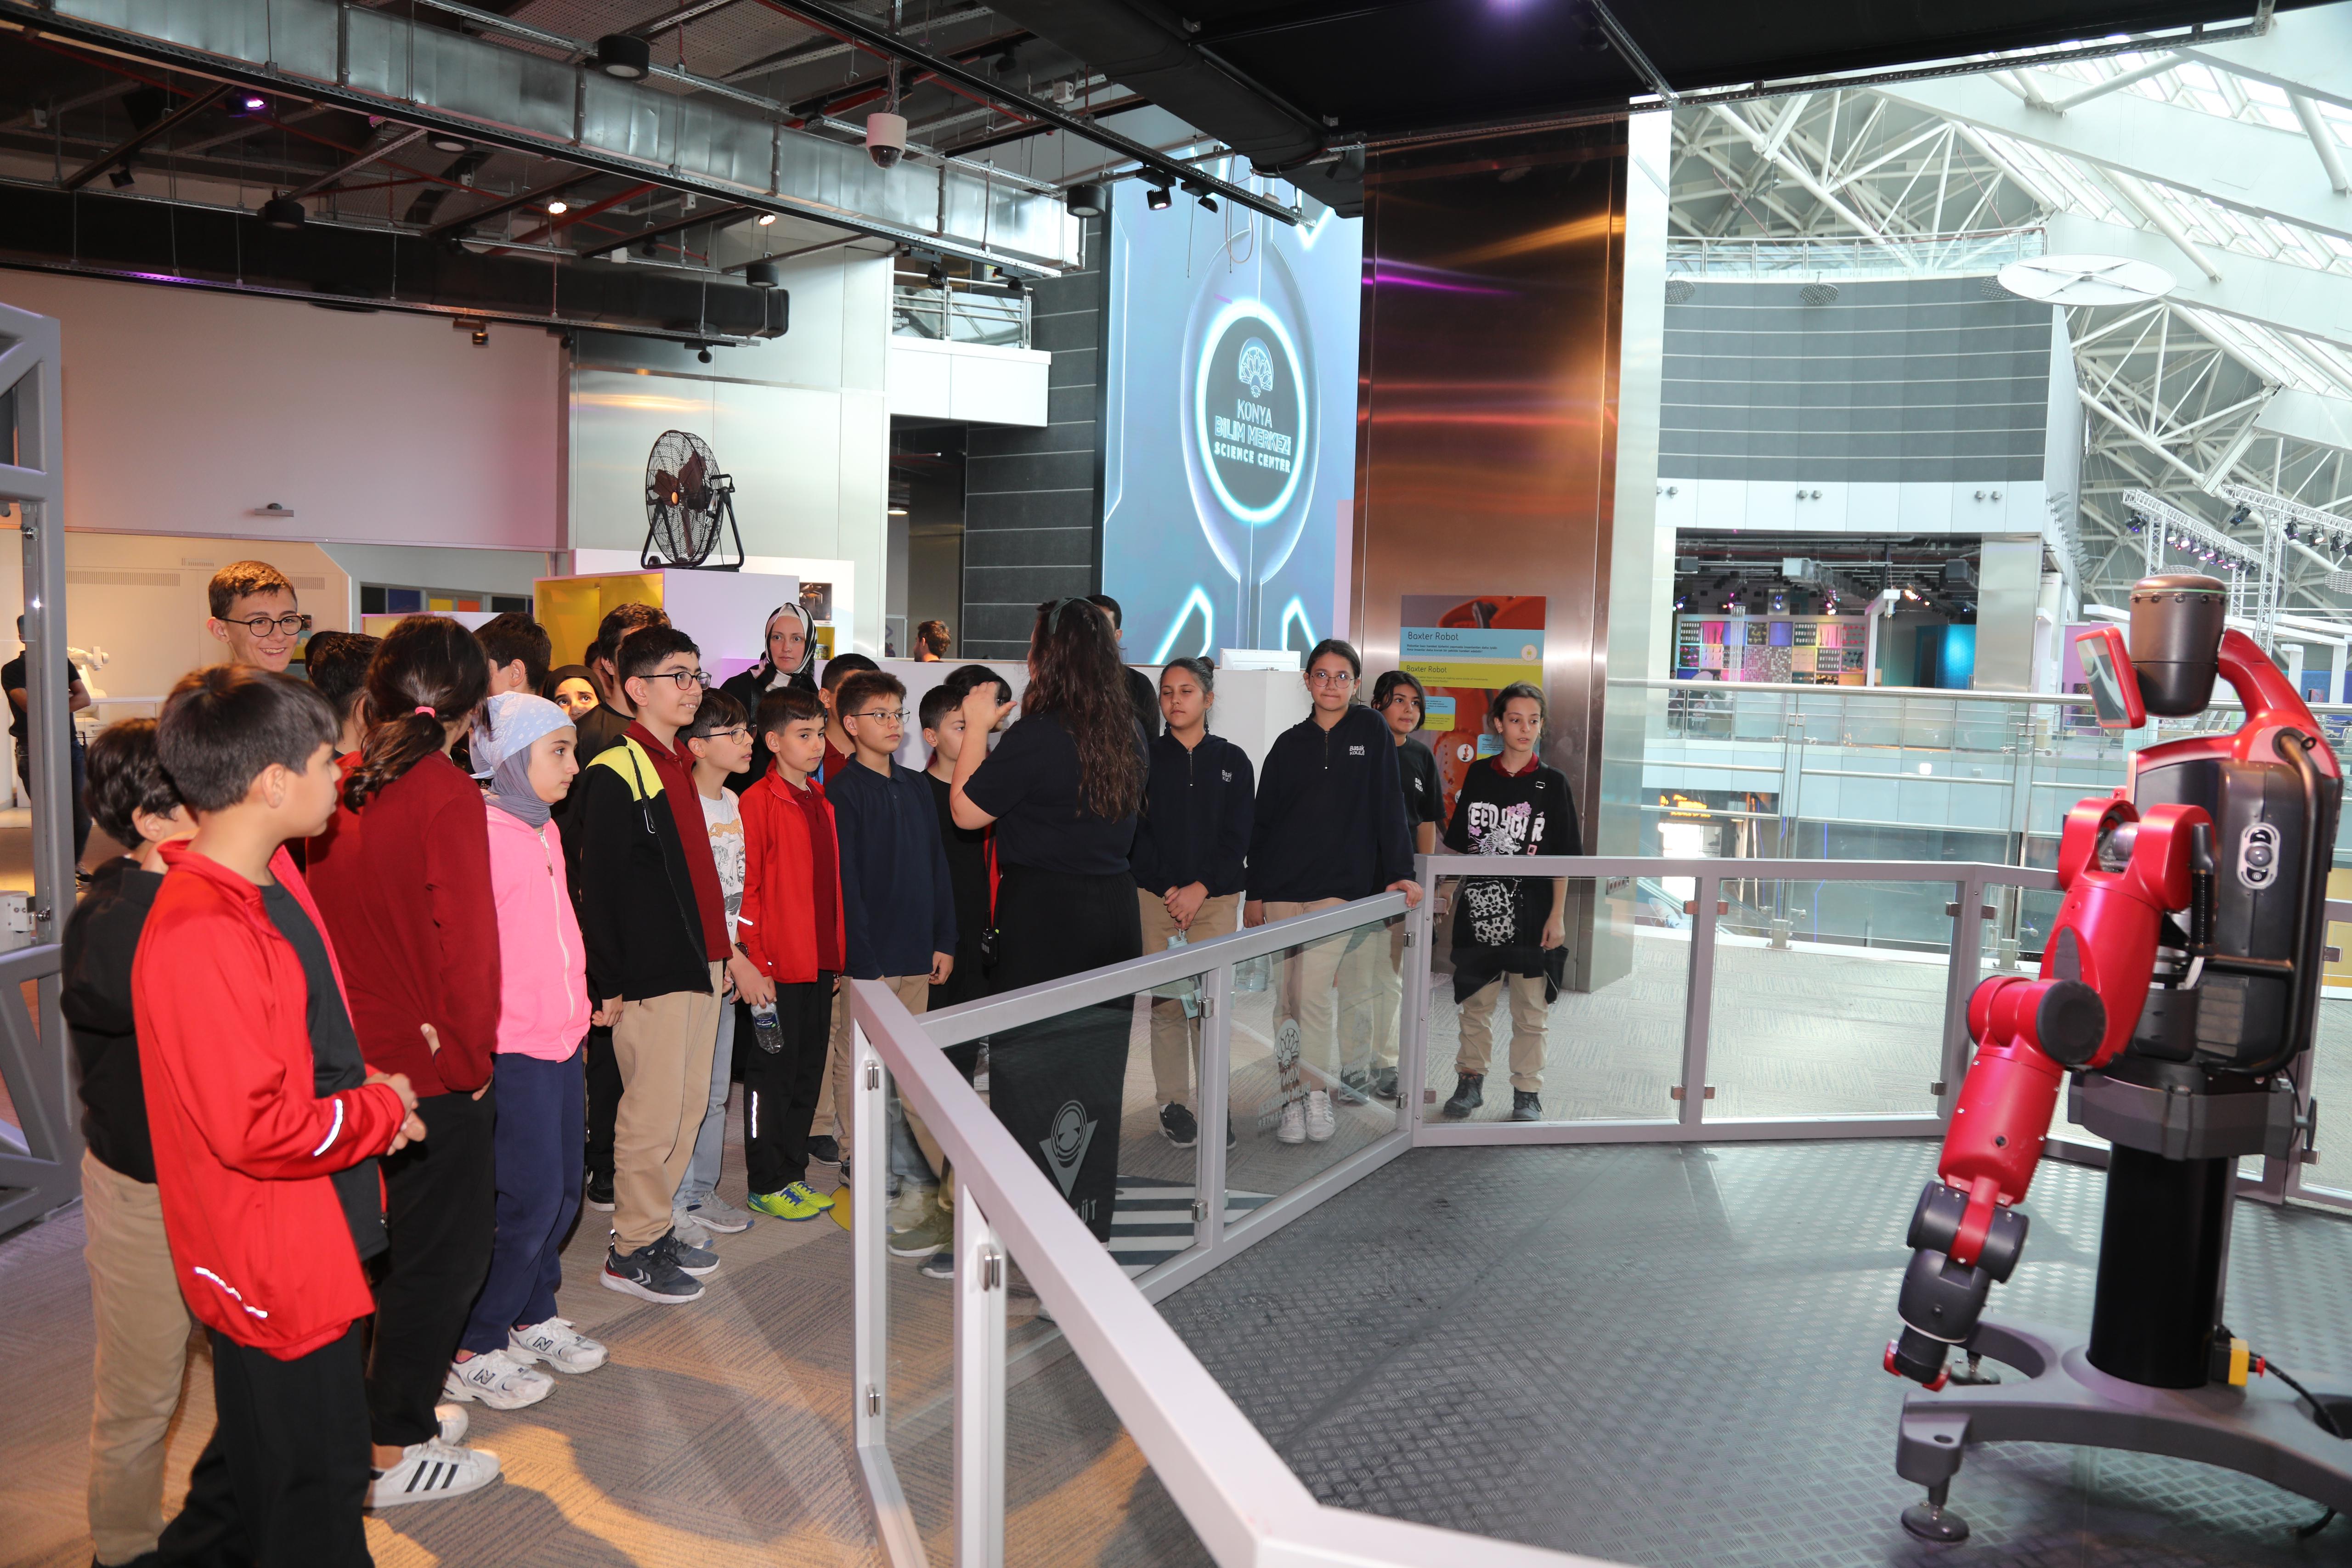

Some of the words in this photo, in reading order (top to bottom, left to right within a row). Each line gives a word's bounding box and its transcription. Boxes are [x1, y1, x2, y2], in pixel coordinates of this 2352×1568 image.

[1238, 399, 1273, 428] KONYA
[1214, 441, 1255, 464] SCIENCE
[1258, 453, 1290, 473] CENTER
[1408, 632, 1433, 640] Baxter
[1436, 632, 1459, 640] Robot
